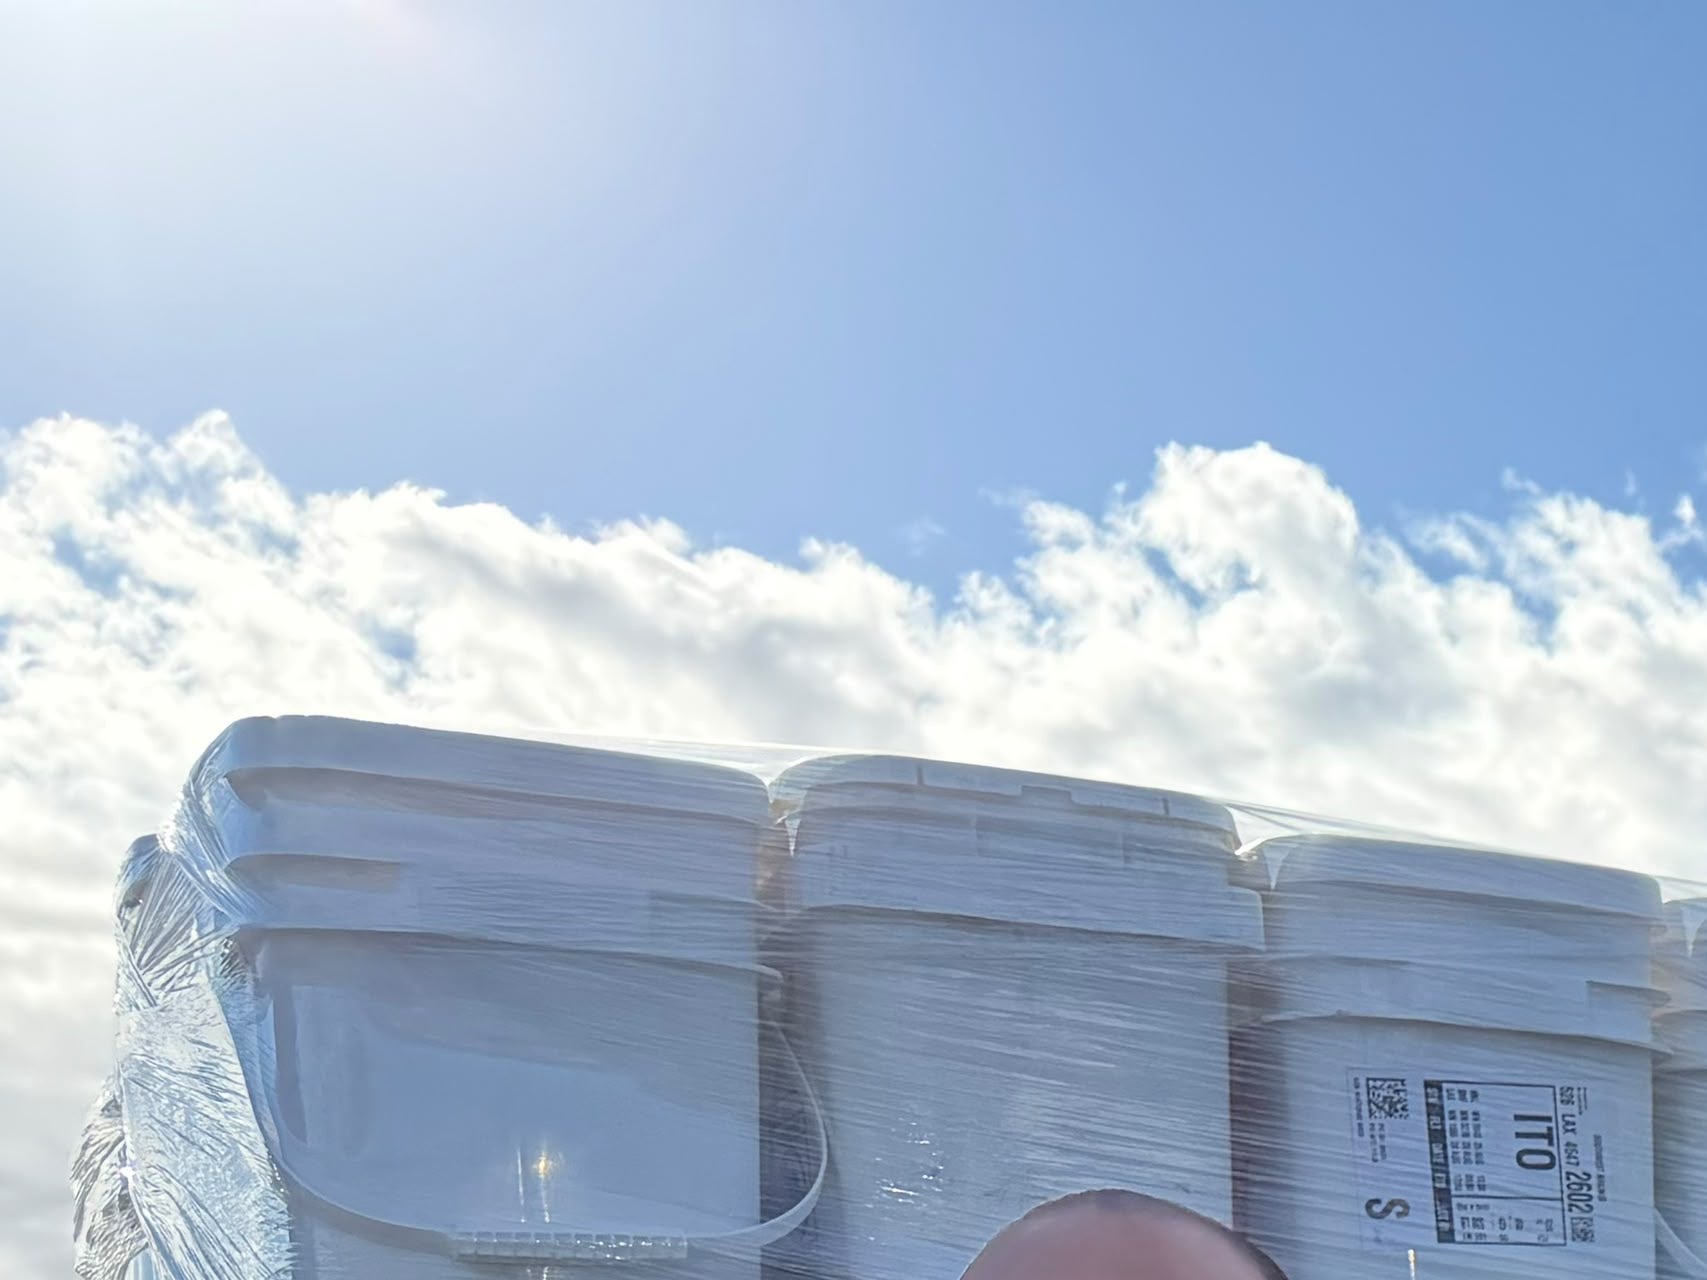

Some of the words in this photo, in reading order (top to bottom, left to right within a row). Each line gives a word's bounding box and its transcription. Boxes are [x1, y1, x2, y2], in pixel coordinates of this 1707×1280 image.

[1561, 1113, 1577, 1134] LAX
[1513, 1114, 1557, 1170] ITO
[1566, 1171, 1594, 1214] 2602
[1364, 1198, 1410, 1220] S
